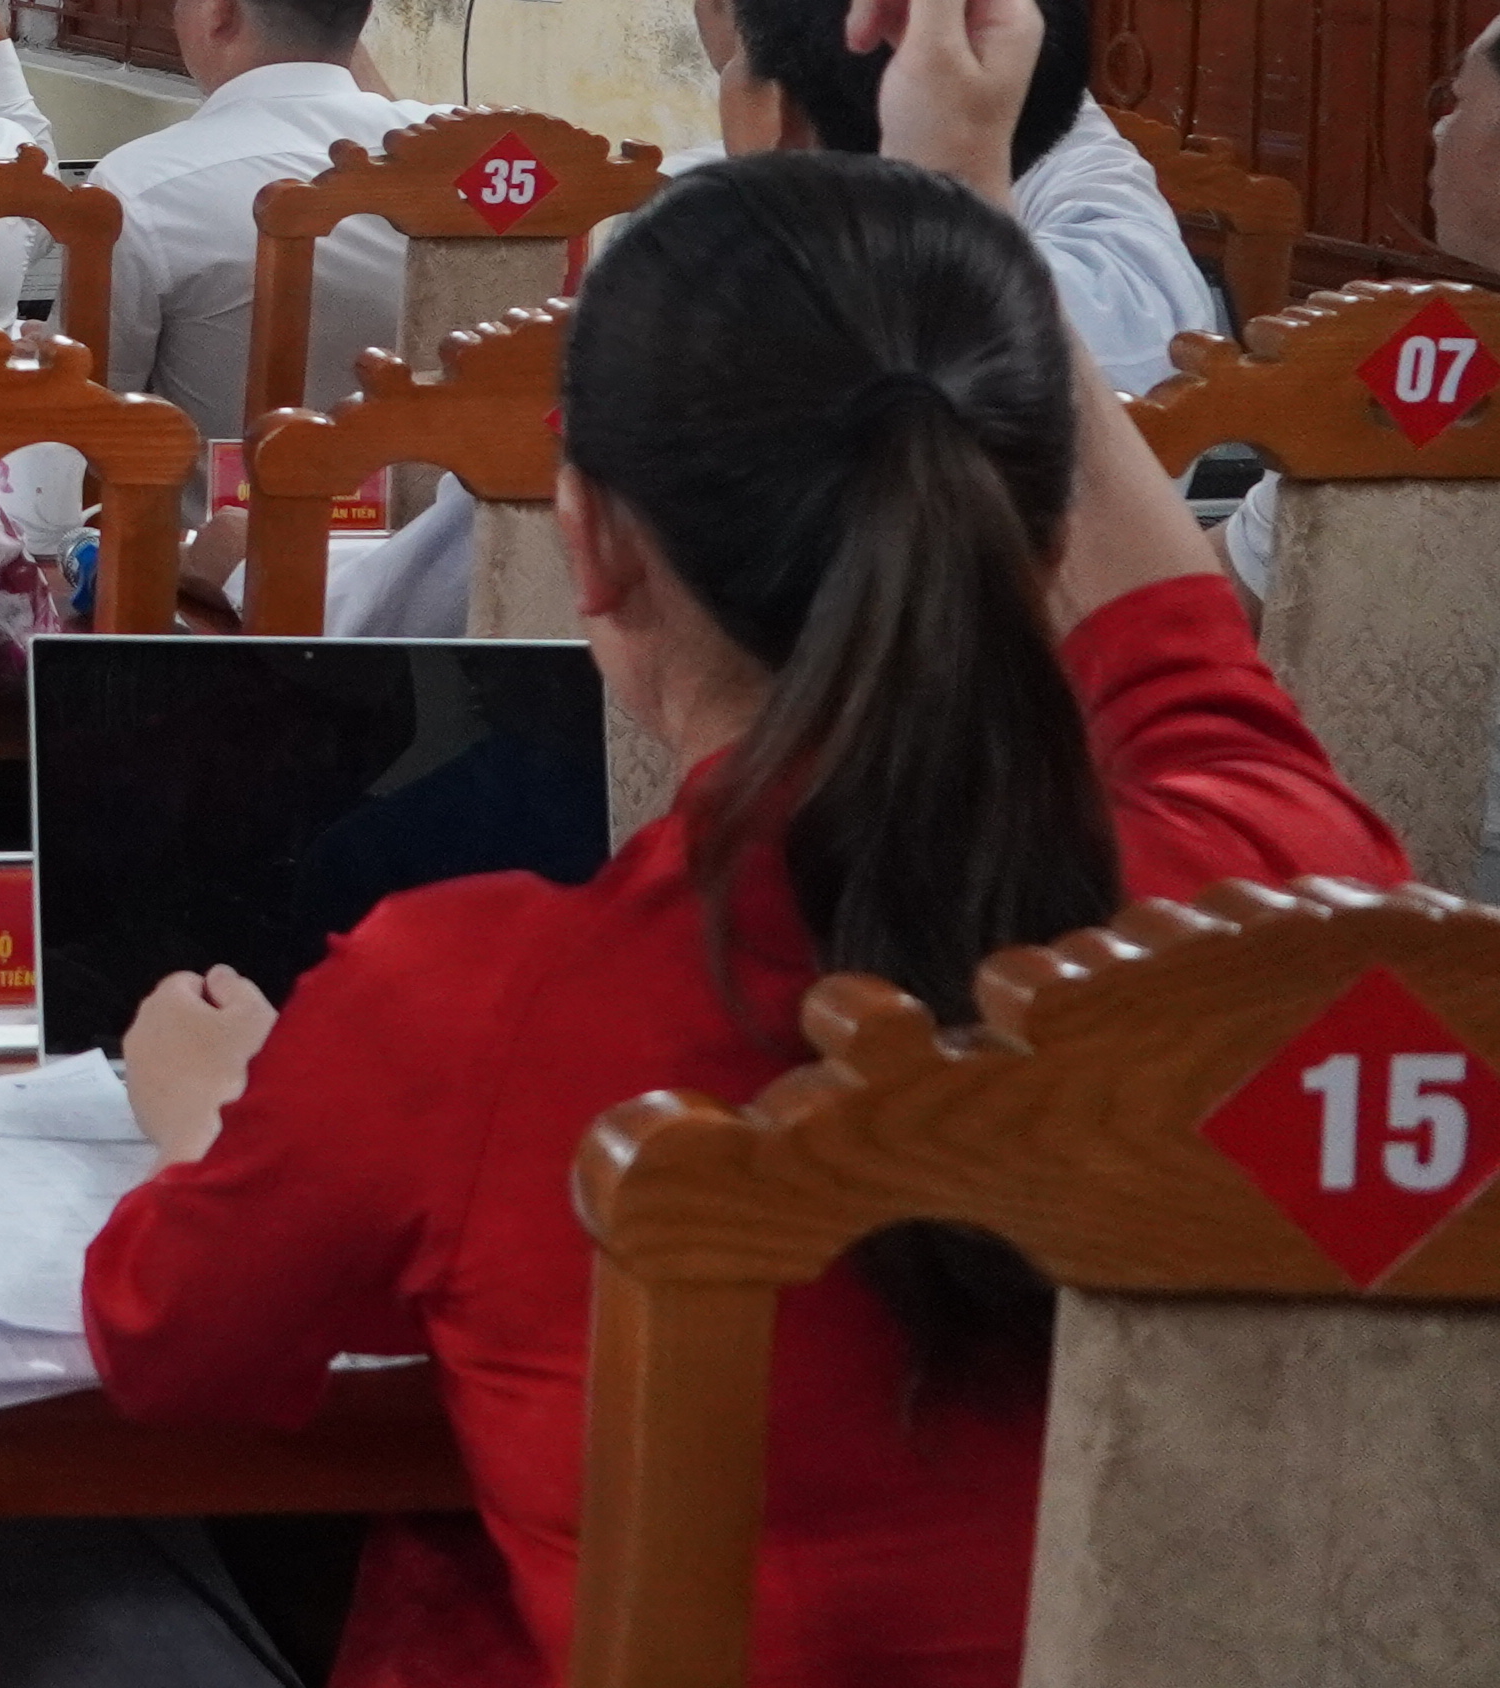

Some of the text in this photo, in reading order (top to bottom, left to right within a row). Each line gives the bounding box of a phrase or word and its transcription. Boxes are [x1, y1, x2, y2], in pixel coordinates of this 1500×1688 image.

[481, 158, 537, 205] 35
[1396, 337, 1479, 404] 07
[1302, 1052, 1470, 1194] 15
